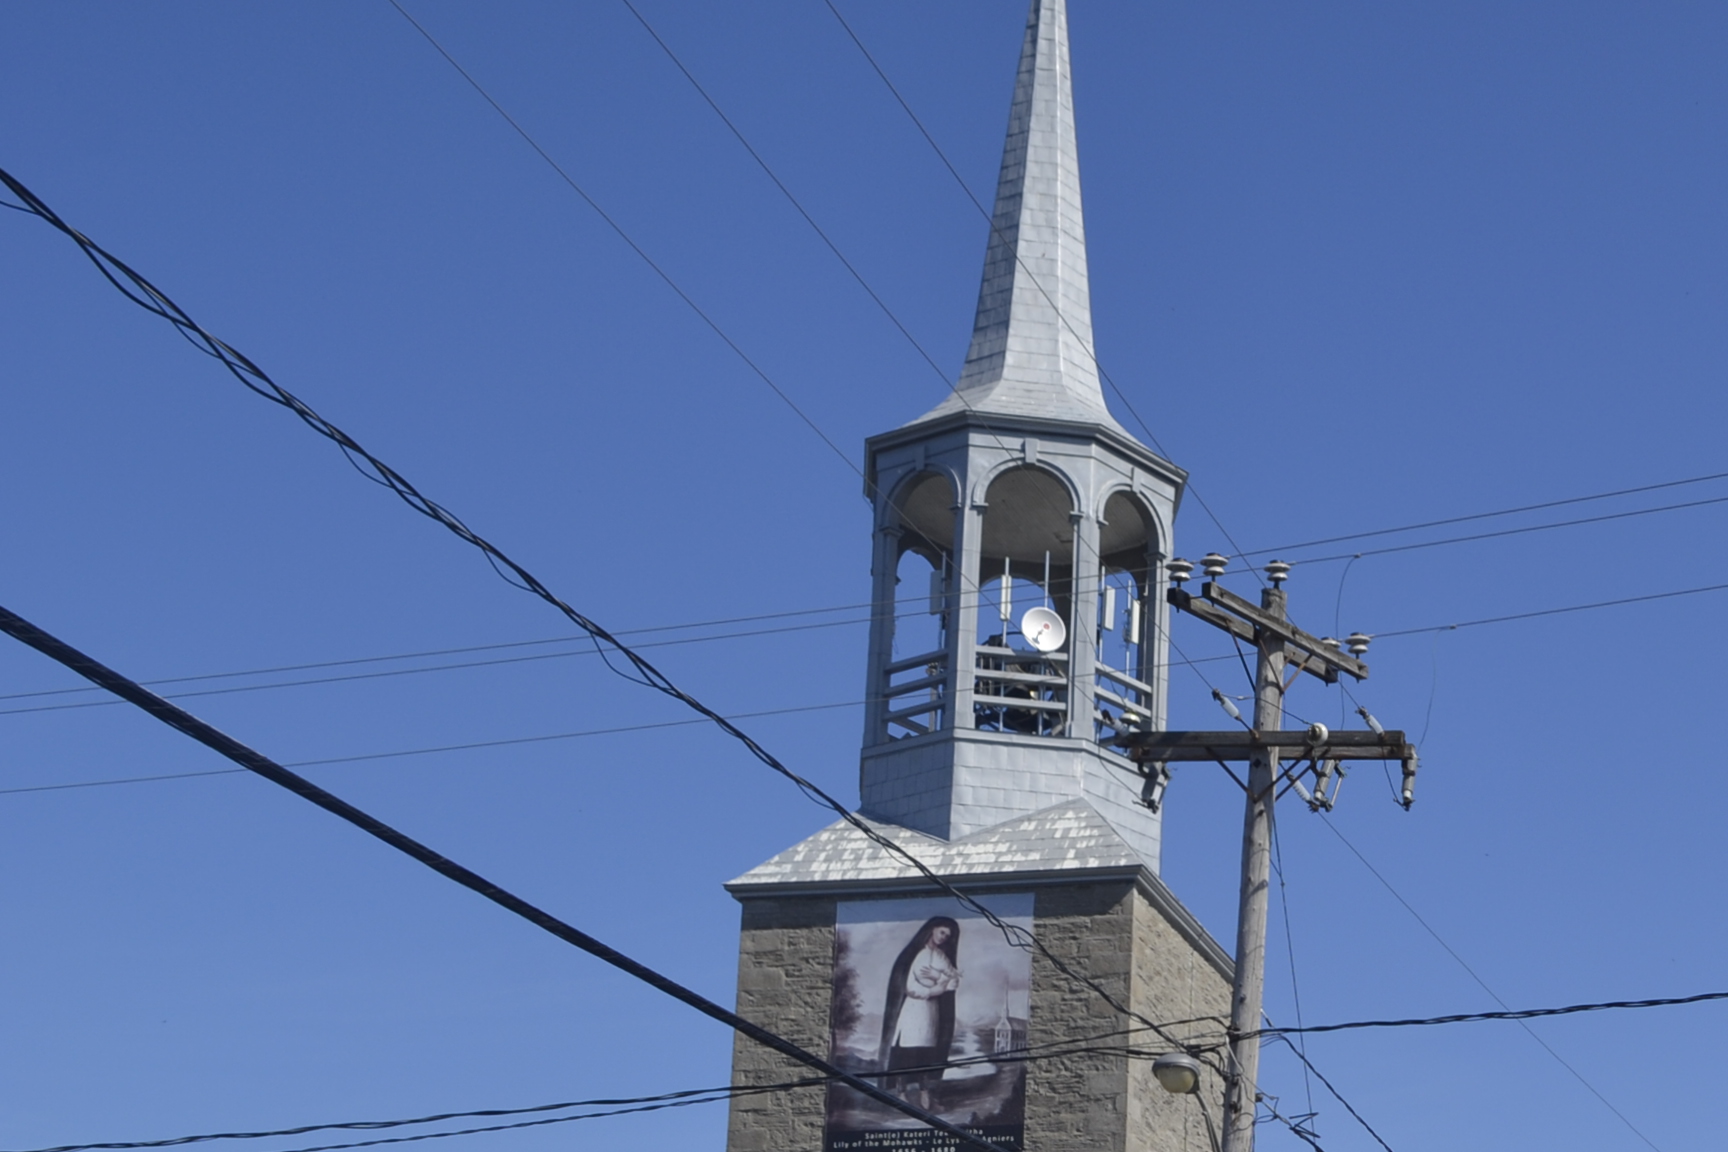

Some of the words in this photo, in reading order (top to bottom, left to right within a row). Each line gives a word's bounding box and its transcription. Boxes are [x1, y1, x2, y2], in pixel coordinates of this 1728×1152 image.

[865, 1132, 900, 1140] Saint(e)
[904, 1130, 931, 1138] Kateri
[833, 1141, 849, 1149] Lily
[865, 1139, 879, 1147] the
[882, 1139, 923, 1147] Mohawks
[945, 1137, 960, 1145] Lys
